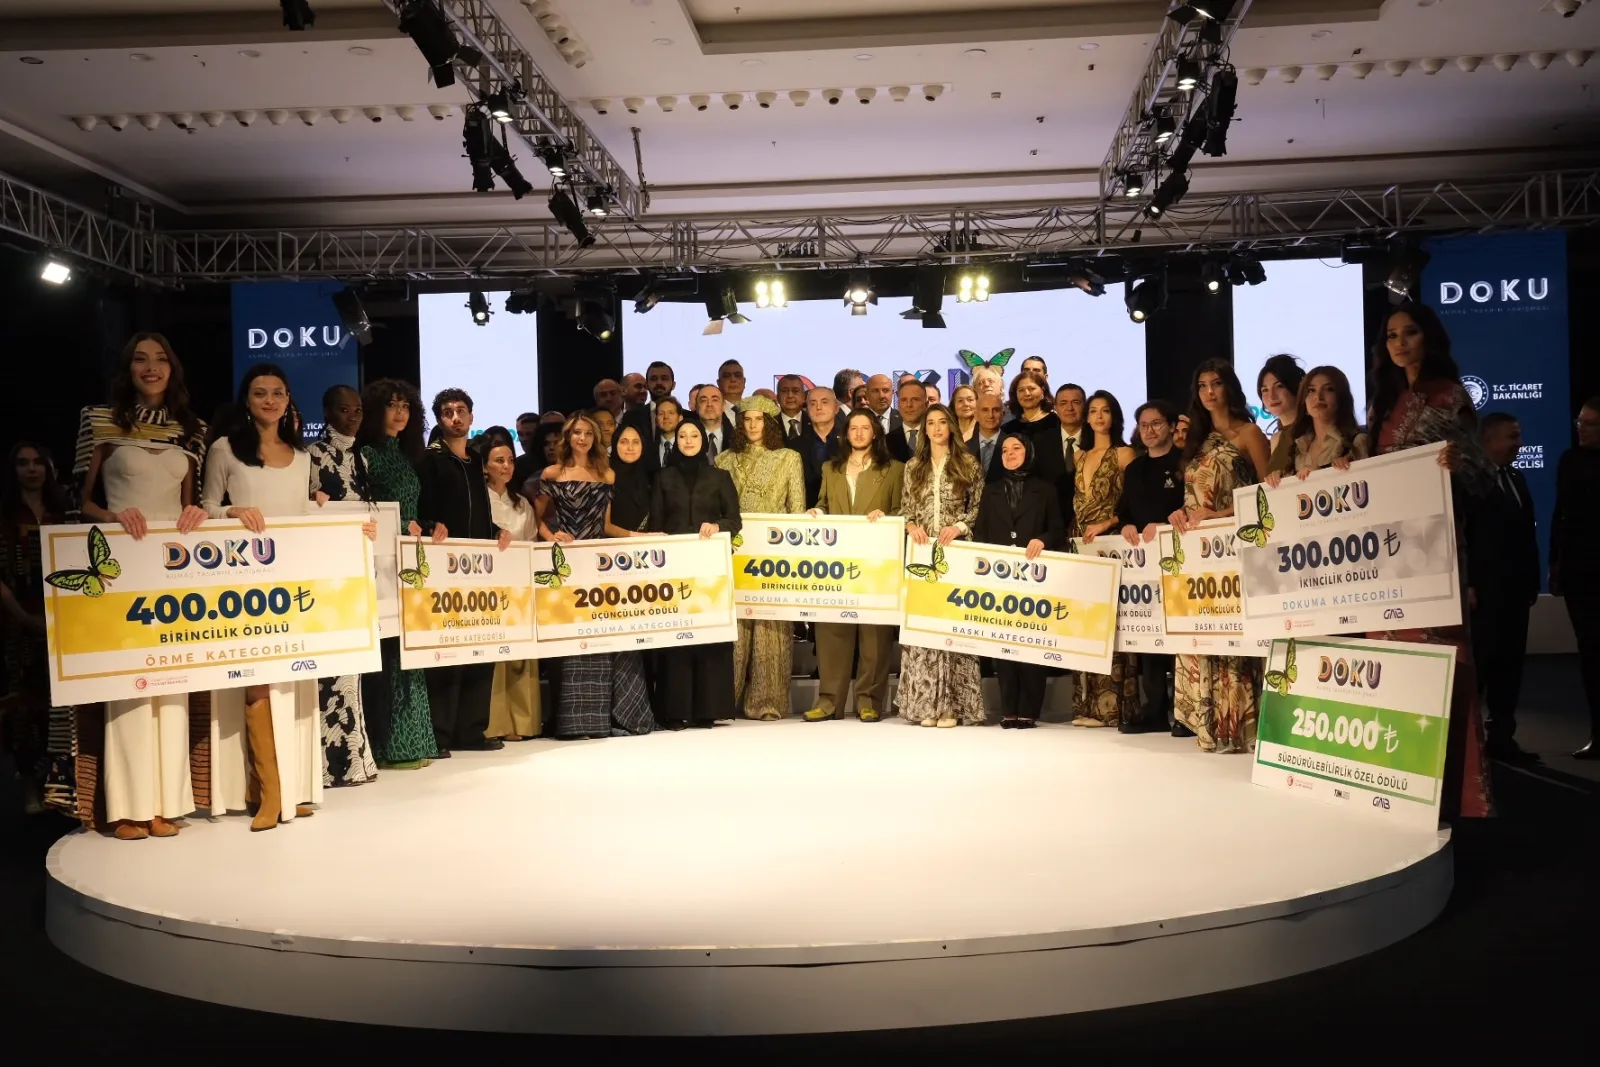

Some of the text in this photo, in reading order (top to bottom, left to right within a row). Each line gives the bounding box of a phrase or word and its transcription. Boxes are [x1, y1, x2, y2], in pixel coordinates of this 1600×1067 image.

[1440, 278, 1548, 304] DOKU
[248, 326, 340, 349] DOKU
[1493, 390, 1542, 400] BAKANLIĞI
[1508, 383, 1543, 391] TİCARET
[1511, 460, 1544, 469] ECLİSİ
[1297, 479, 1369, 520] DOKU
[767, 527, 837, 546] DOKU
[1200, 534, 1236, 558] DOK
[162, 537, 276, 571] DOKU
[447, 552, 493, 574] DOKU
[596, 549, 666, 572] DOKU
[973, 556, 1047, 583] DOKU
[1300, 566, 1379, 589] İKİNCİLİK ÖDÜLÜ
[761, 582, 843, 592] BİRİNCİLİK ÖDÜLÜ
[1282, 585, 1404, 611] DOKUMA KATEGORİSİ
[744, 595, 860, 606] DOKUMA KATEGORİSİ
[591, 606, 679, 621] ÜÇÜNCÜLÜK ÖDÜLÜ
[964, 614, 1048, 632] BİRİNCİLİK ÖDÜLÜ
[160, 621, 290, 643] BİRİNCİLİK ÖDÜLÜ
[578, 618, 693, 636] DOKUMA KATEGORİSİ
[952, 626, 985, 637] BASKI
[991, 631, 1058, 648] KATEGORİSİ
[146, 640, 305, 667] ÖRME KATEGORİSİ
[1317, 655, 1382, 690] DOKU
[1278, 752, 1408, 791] SÜRDÜRÜLEBİLİRLİK ÖZEL ÖDÜLÜ
